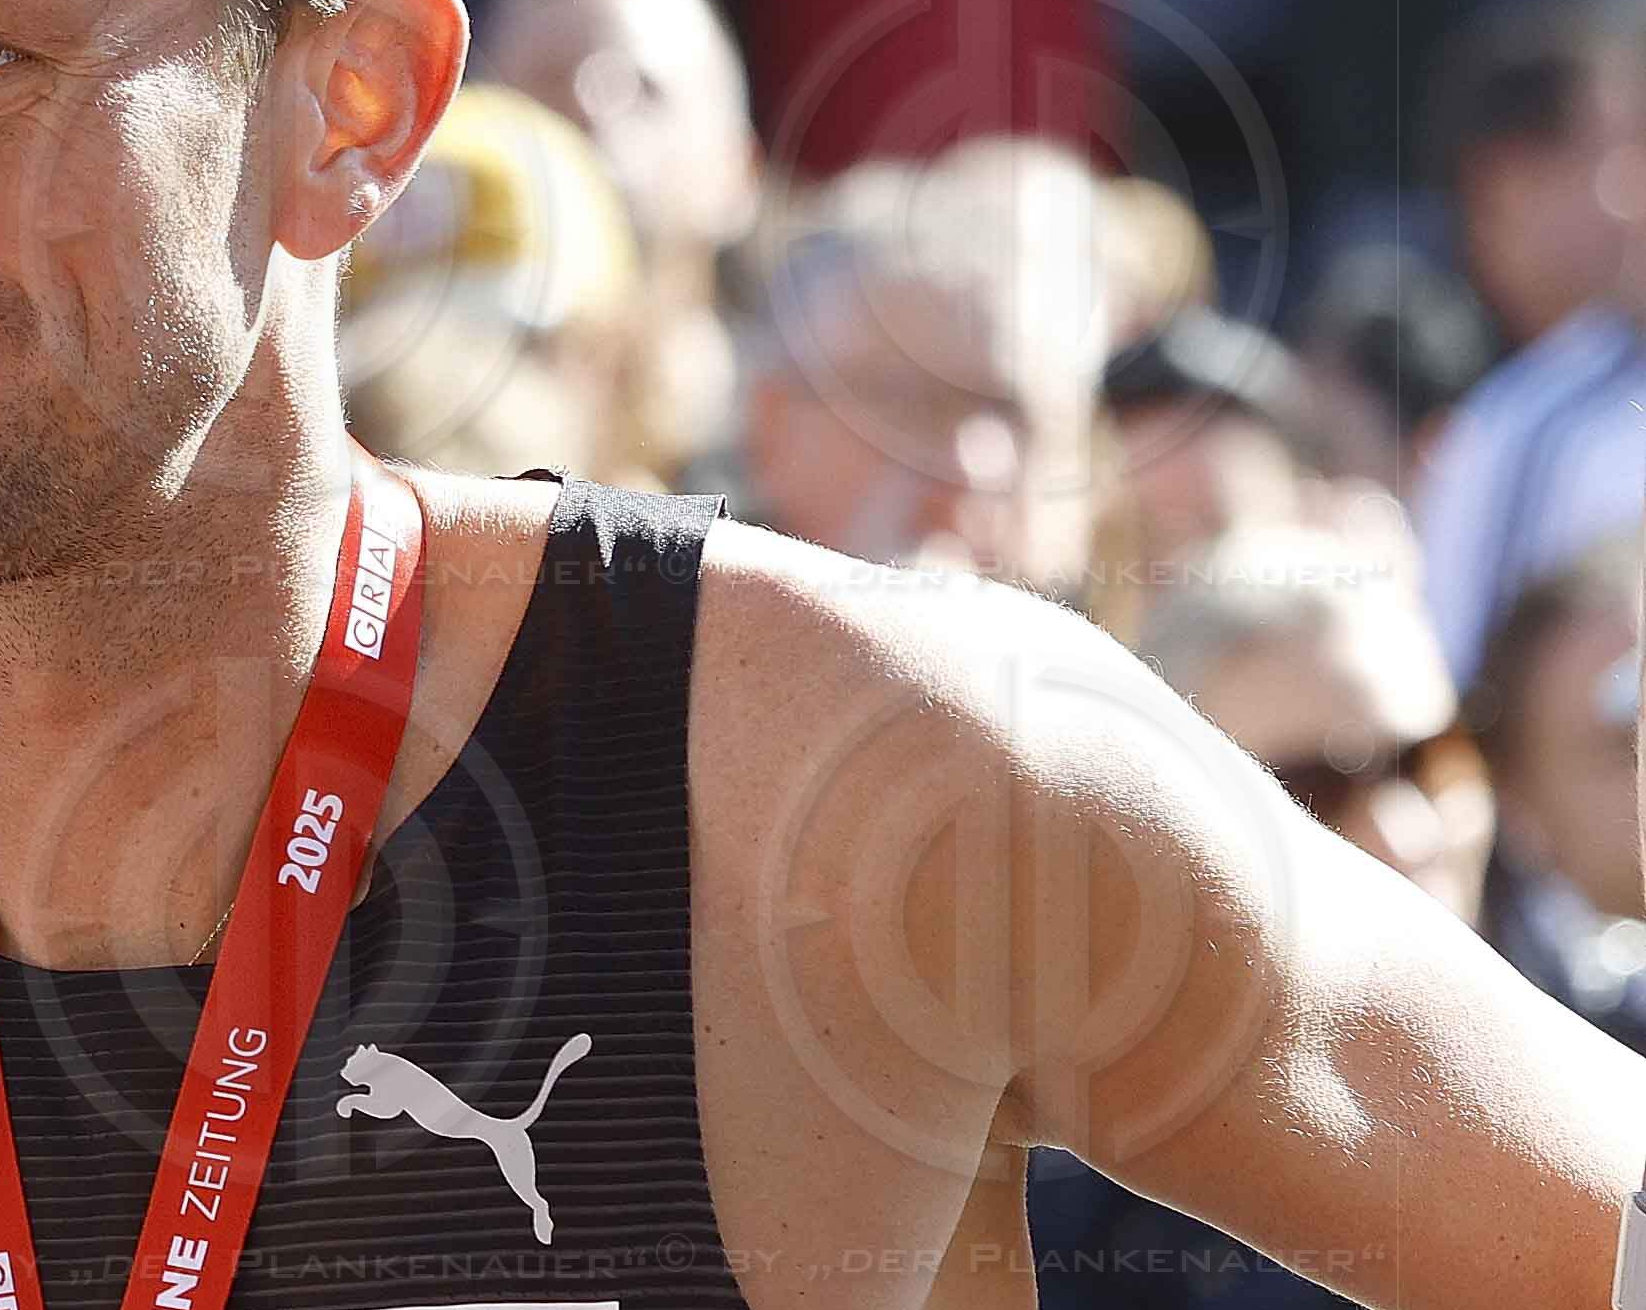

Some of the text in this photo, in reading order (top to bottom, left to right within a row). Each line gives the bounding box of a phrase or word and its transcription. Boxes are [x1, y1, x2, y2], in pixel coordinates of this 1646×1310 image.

[353, 547, 390, 649] GRA
[278, 789, 345, 894] 2025
[180, 1026, 268, 1221] ZEITUNG
